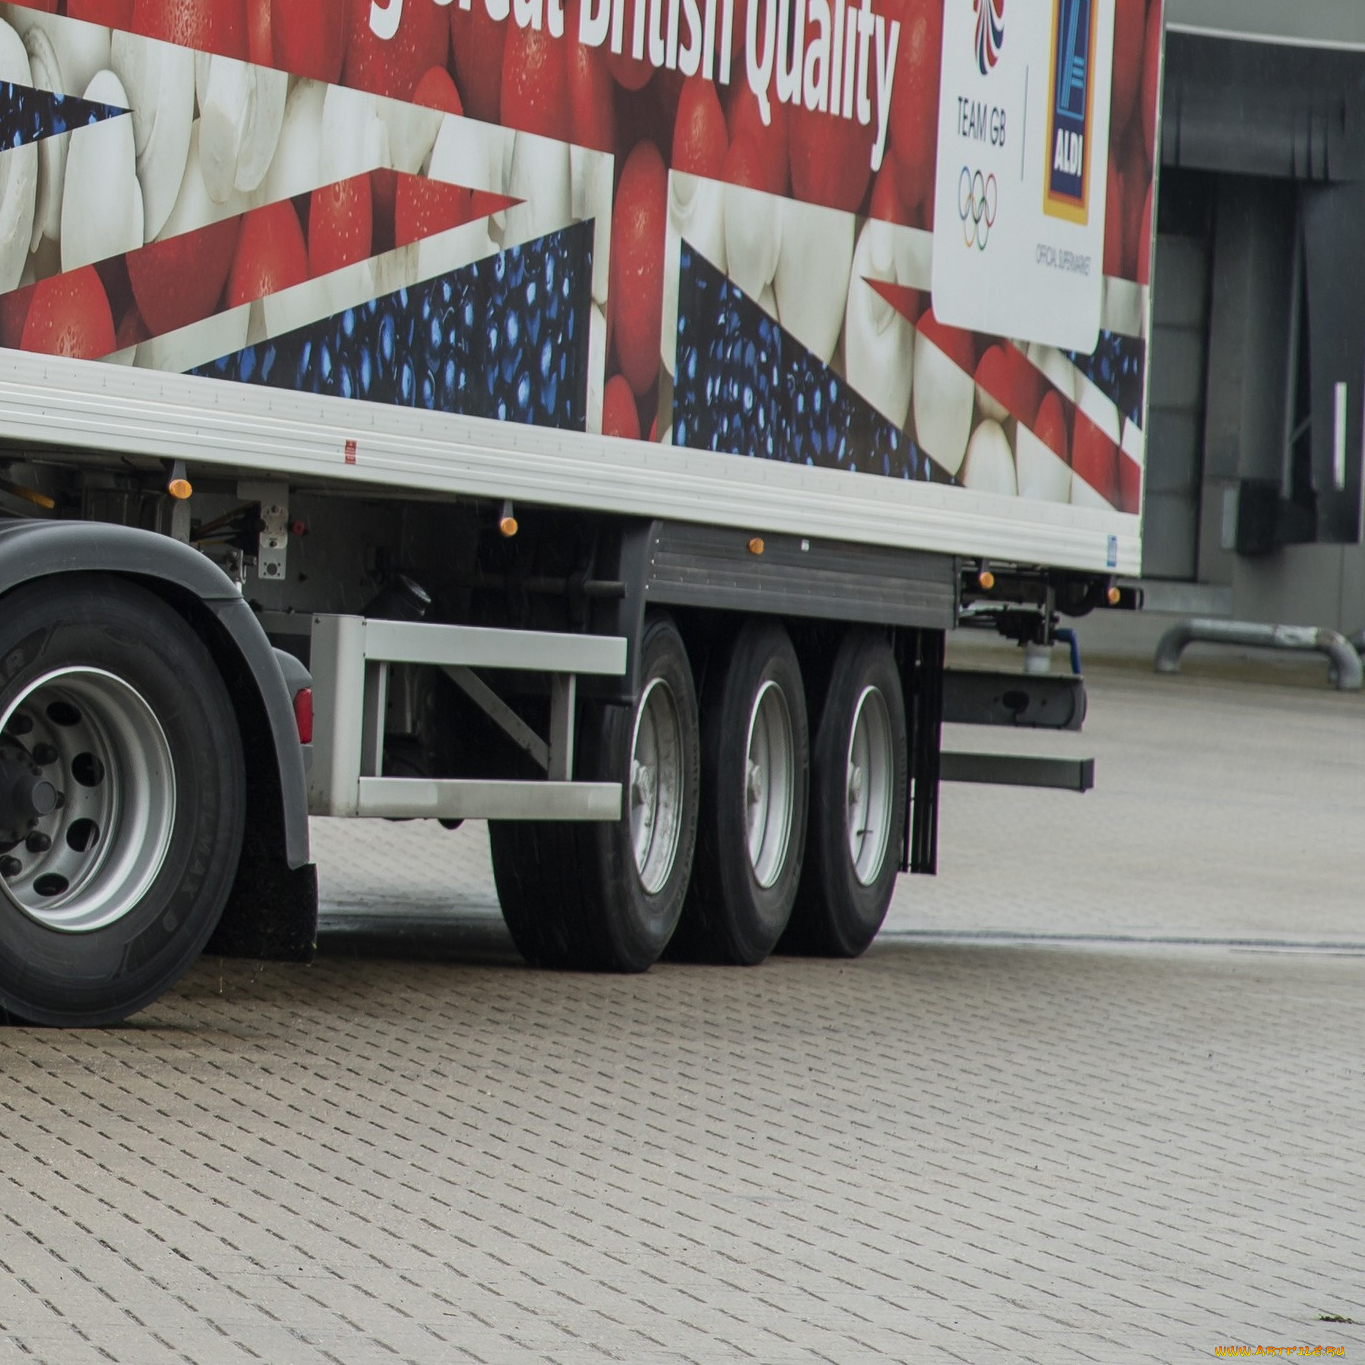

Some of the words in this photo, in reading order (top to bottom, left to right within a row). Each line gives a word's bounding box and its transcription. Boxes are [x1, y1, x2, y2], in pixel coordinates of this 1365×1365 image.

[958, 96, 987, 142] TEAM
[990, 107, 1006, 147] GB
[1054, 128, 1083, 177] ALDI
